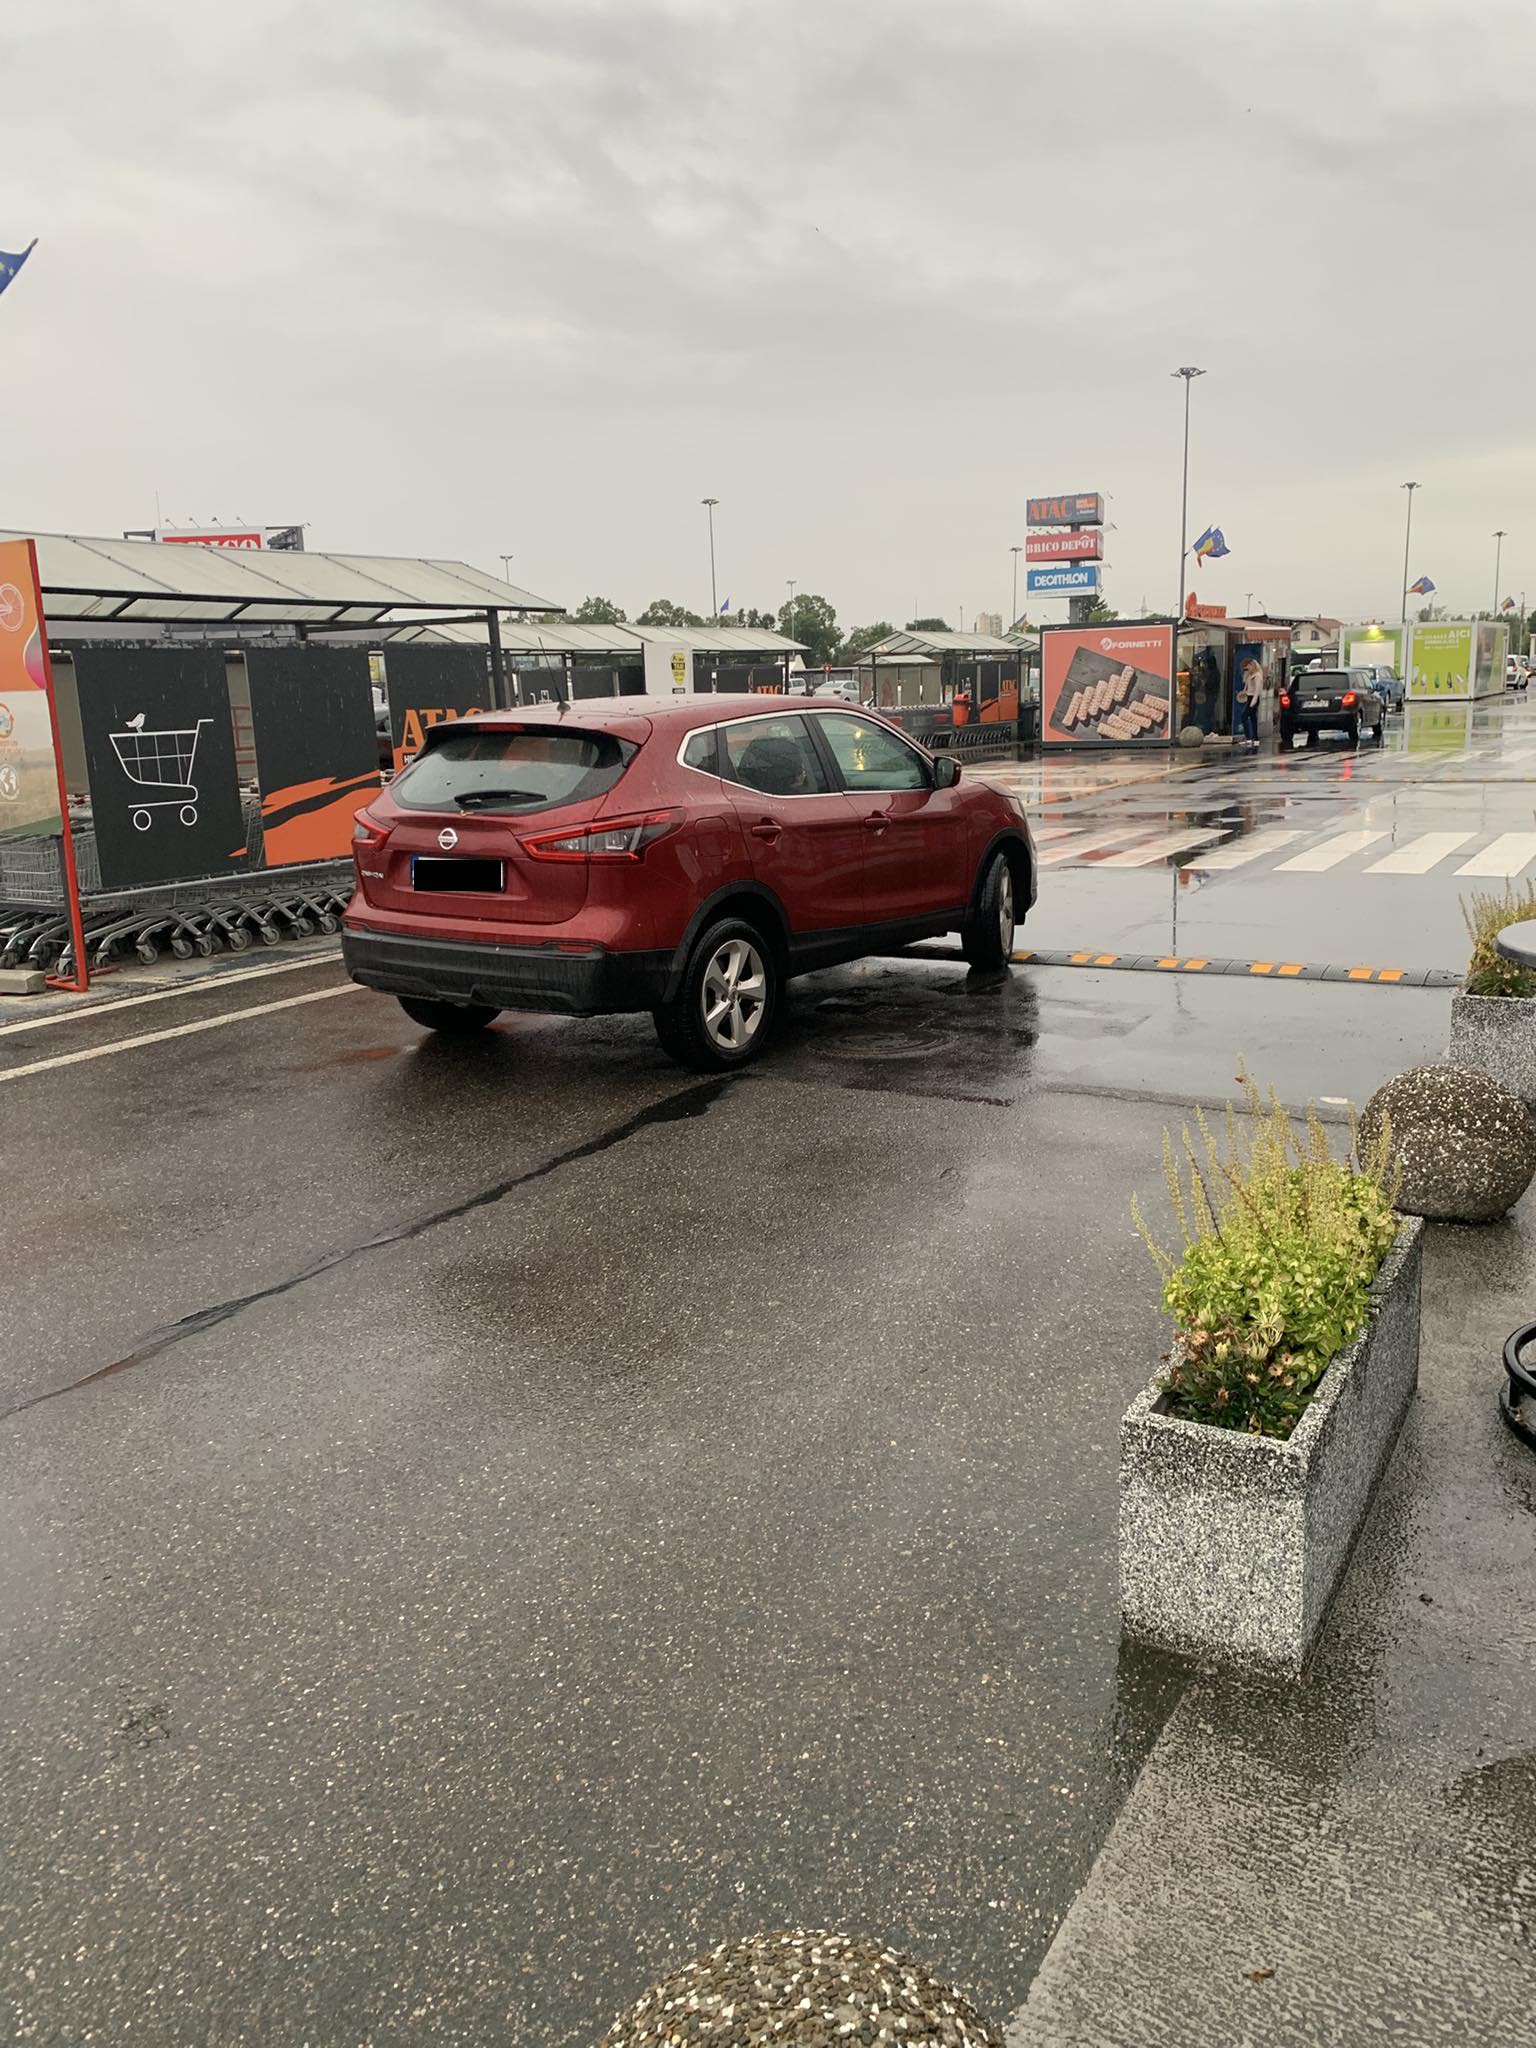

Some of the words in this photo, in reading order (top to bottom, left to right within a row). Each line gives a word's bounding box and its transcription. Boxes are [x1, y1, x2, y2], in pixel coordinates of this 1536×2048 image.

[1028, 497, 1072, 520] ATAC
[1026, 541, 1059, 554] BRICO
[1034, 573, 1088, 587] DECATHLON
[1111, 639, 1162, 649] FORNETTI
